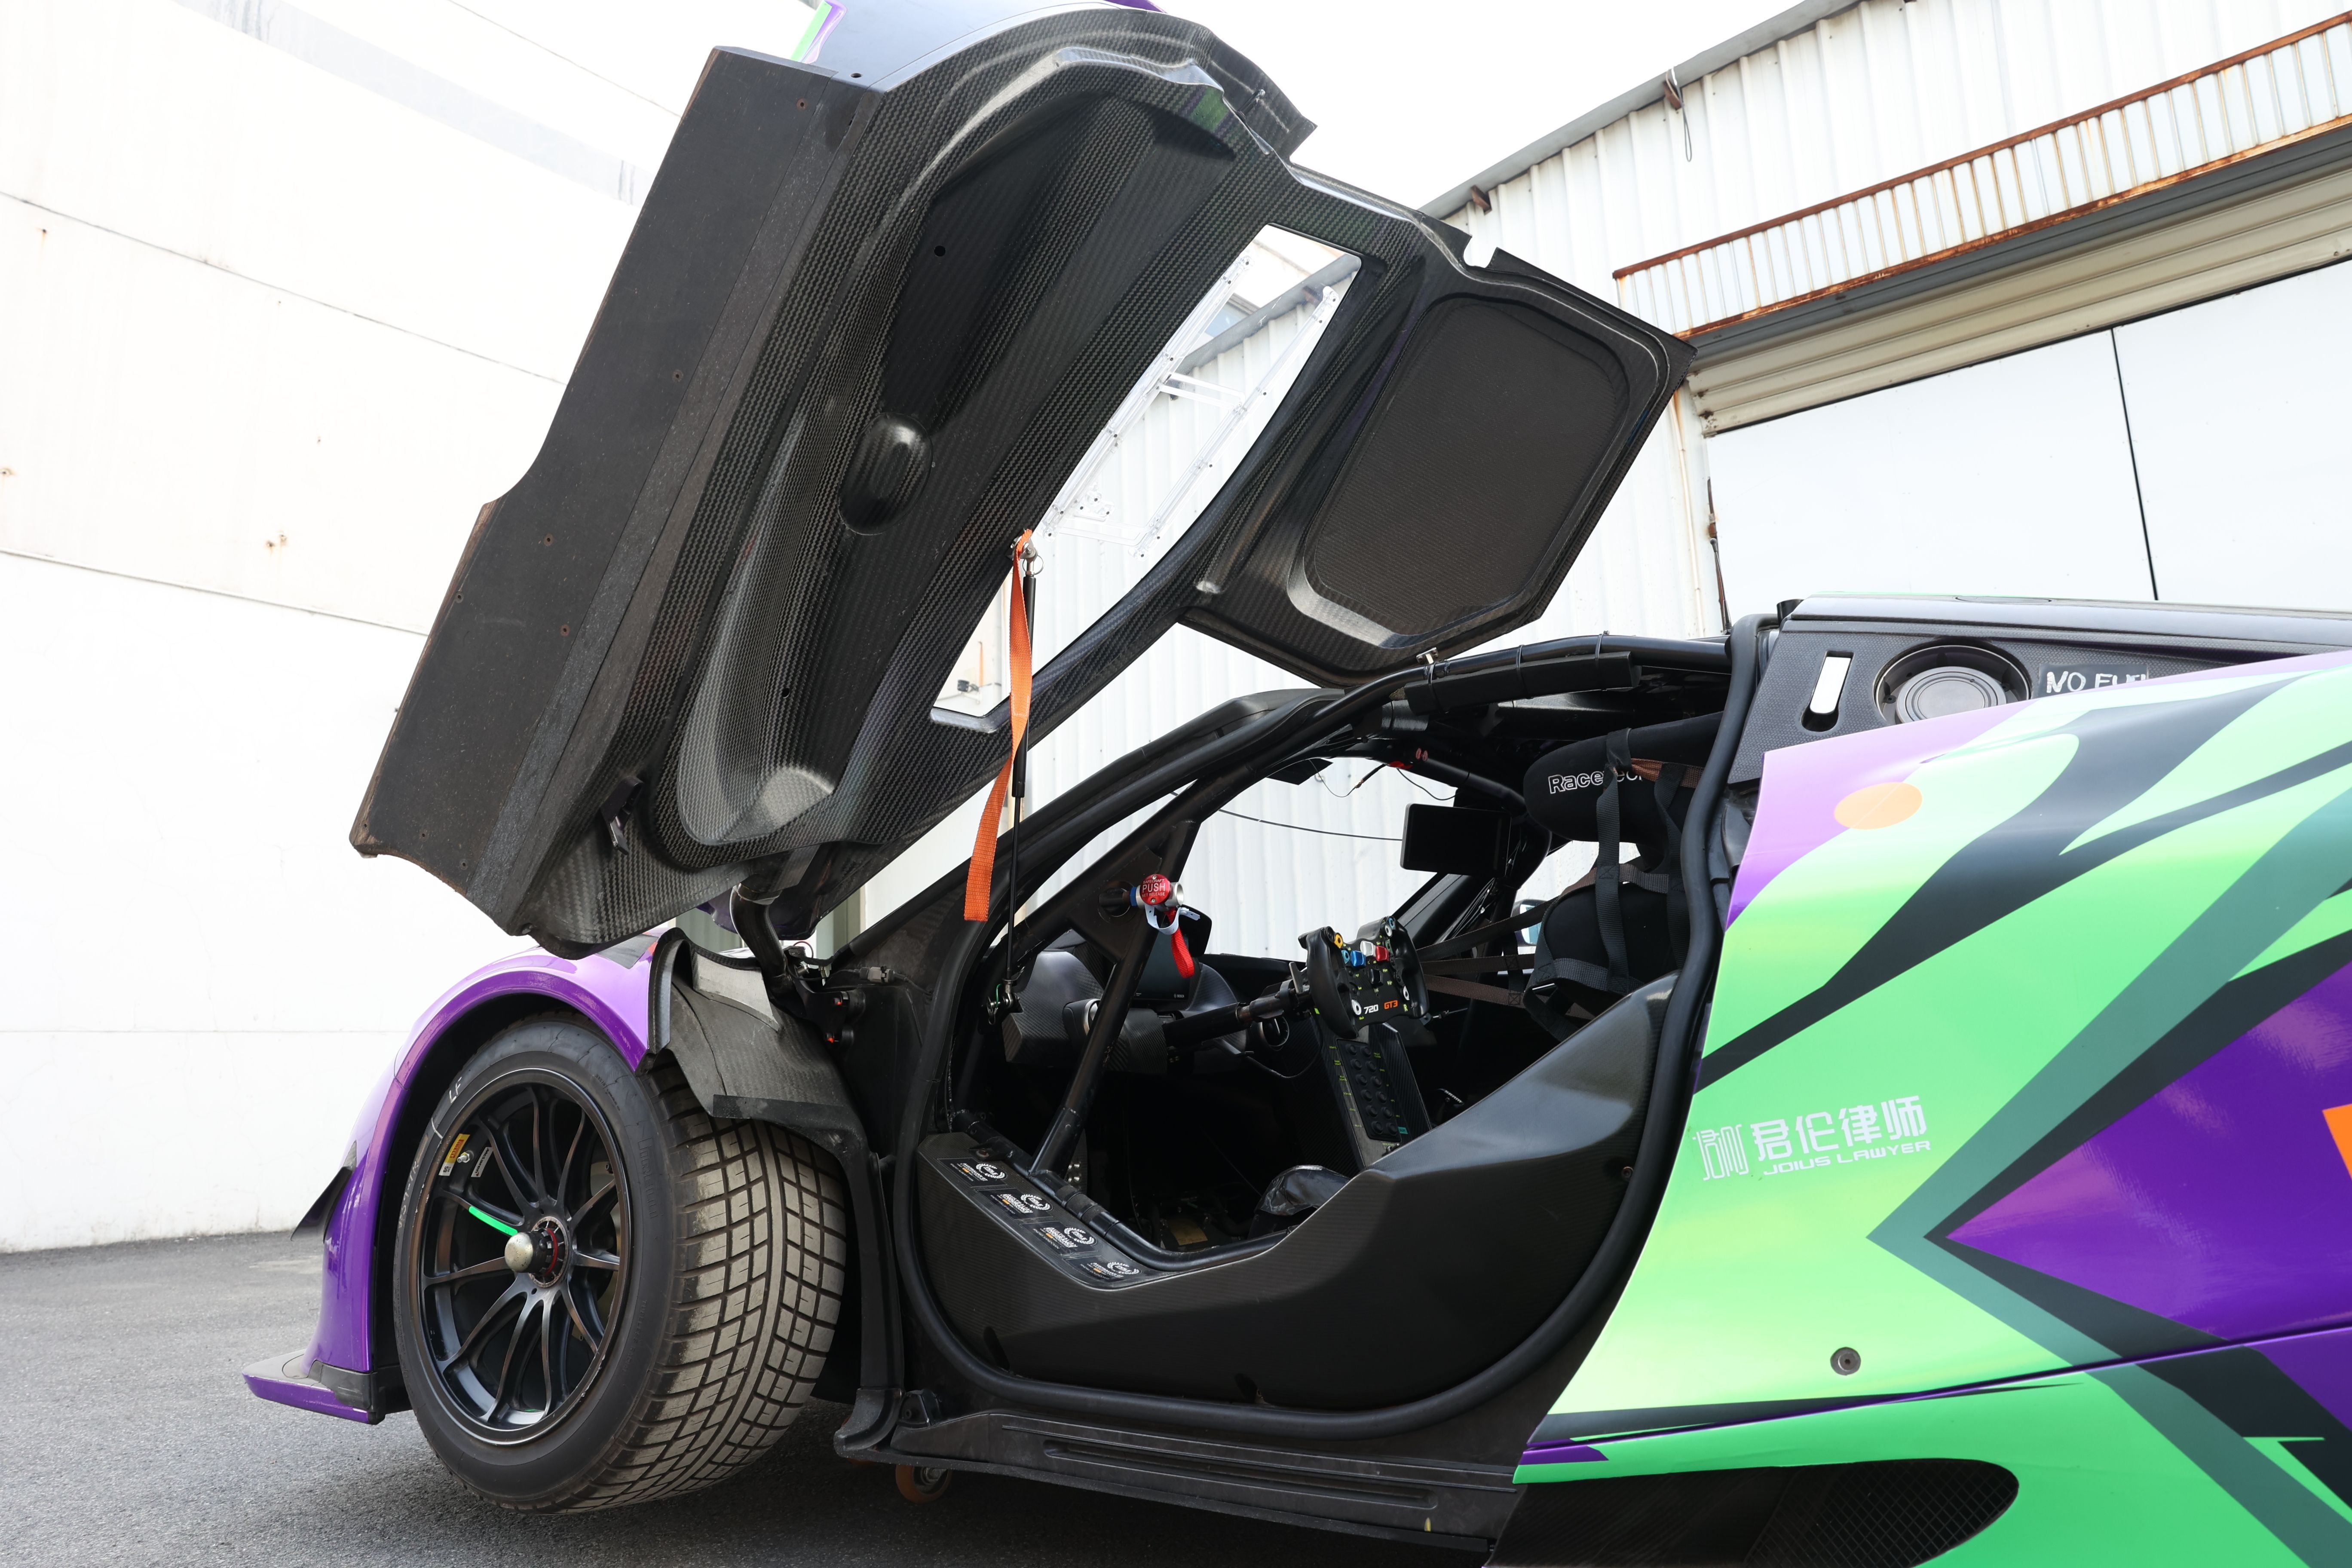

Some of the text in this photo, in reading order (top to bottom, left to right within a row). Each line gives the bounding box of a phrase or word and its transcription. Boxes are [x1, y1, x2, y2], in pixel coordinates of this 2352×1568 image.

[2046, 671, 2086, 693] NO
[1142, 883, 1165, 893] PUSH
[1363, 1004, 1378, 1014] 720
[1384, 1000, 1398, 1009] GT3
[1750, 1095, 1926, 1161] 君伦律师
[475, 1148, 489, 1173] McLaren
[1764, 1140, 1931, 1175] JOIUS LAWYER
